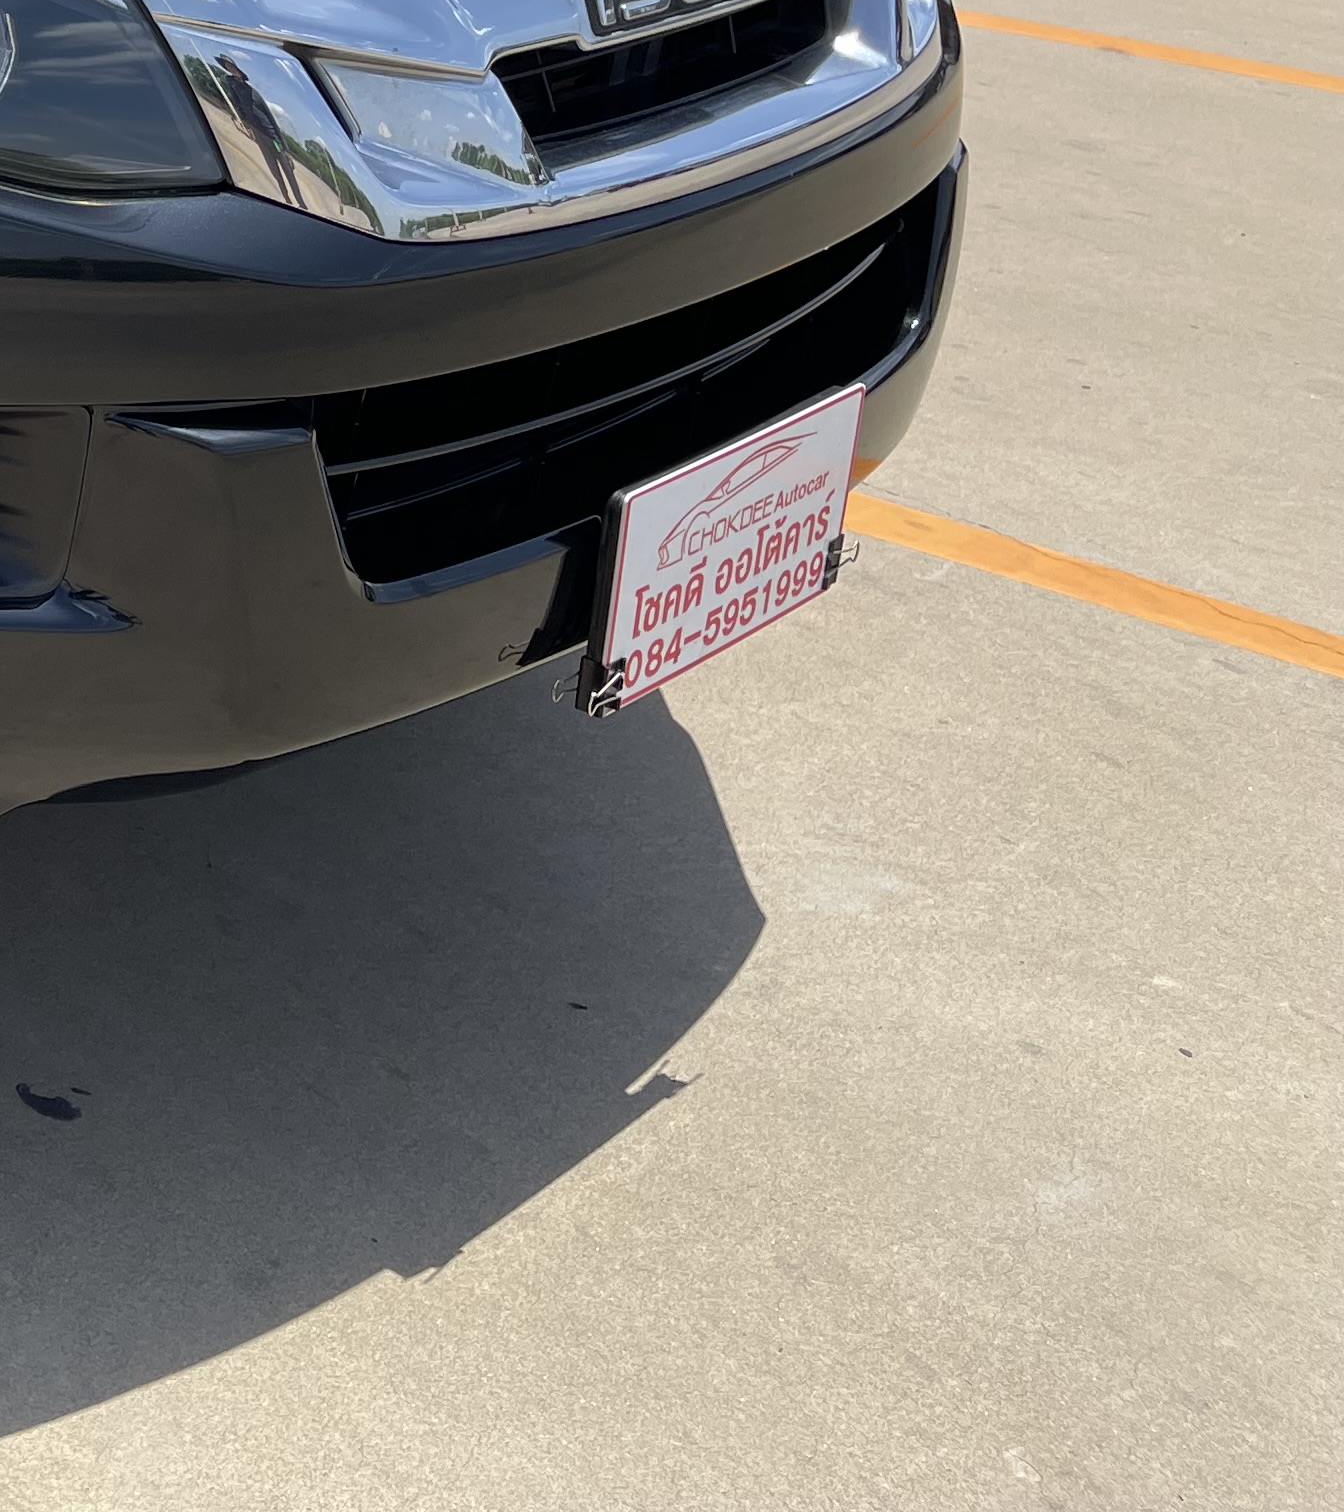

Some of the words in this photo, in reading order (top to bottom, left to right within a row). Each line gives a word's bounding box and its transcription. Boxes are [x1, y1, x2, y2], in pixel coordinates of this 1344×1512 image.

[632, 556, 707, 640] โชคดี
[715, 488, 836, 595] ออโต้คาร์
[687, 493, 774, 557] CHOKDEE
[773, 470, 830, 514] Autocar
[624, 550, 824, 689] 084-5951999
